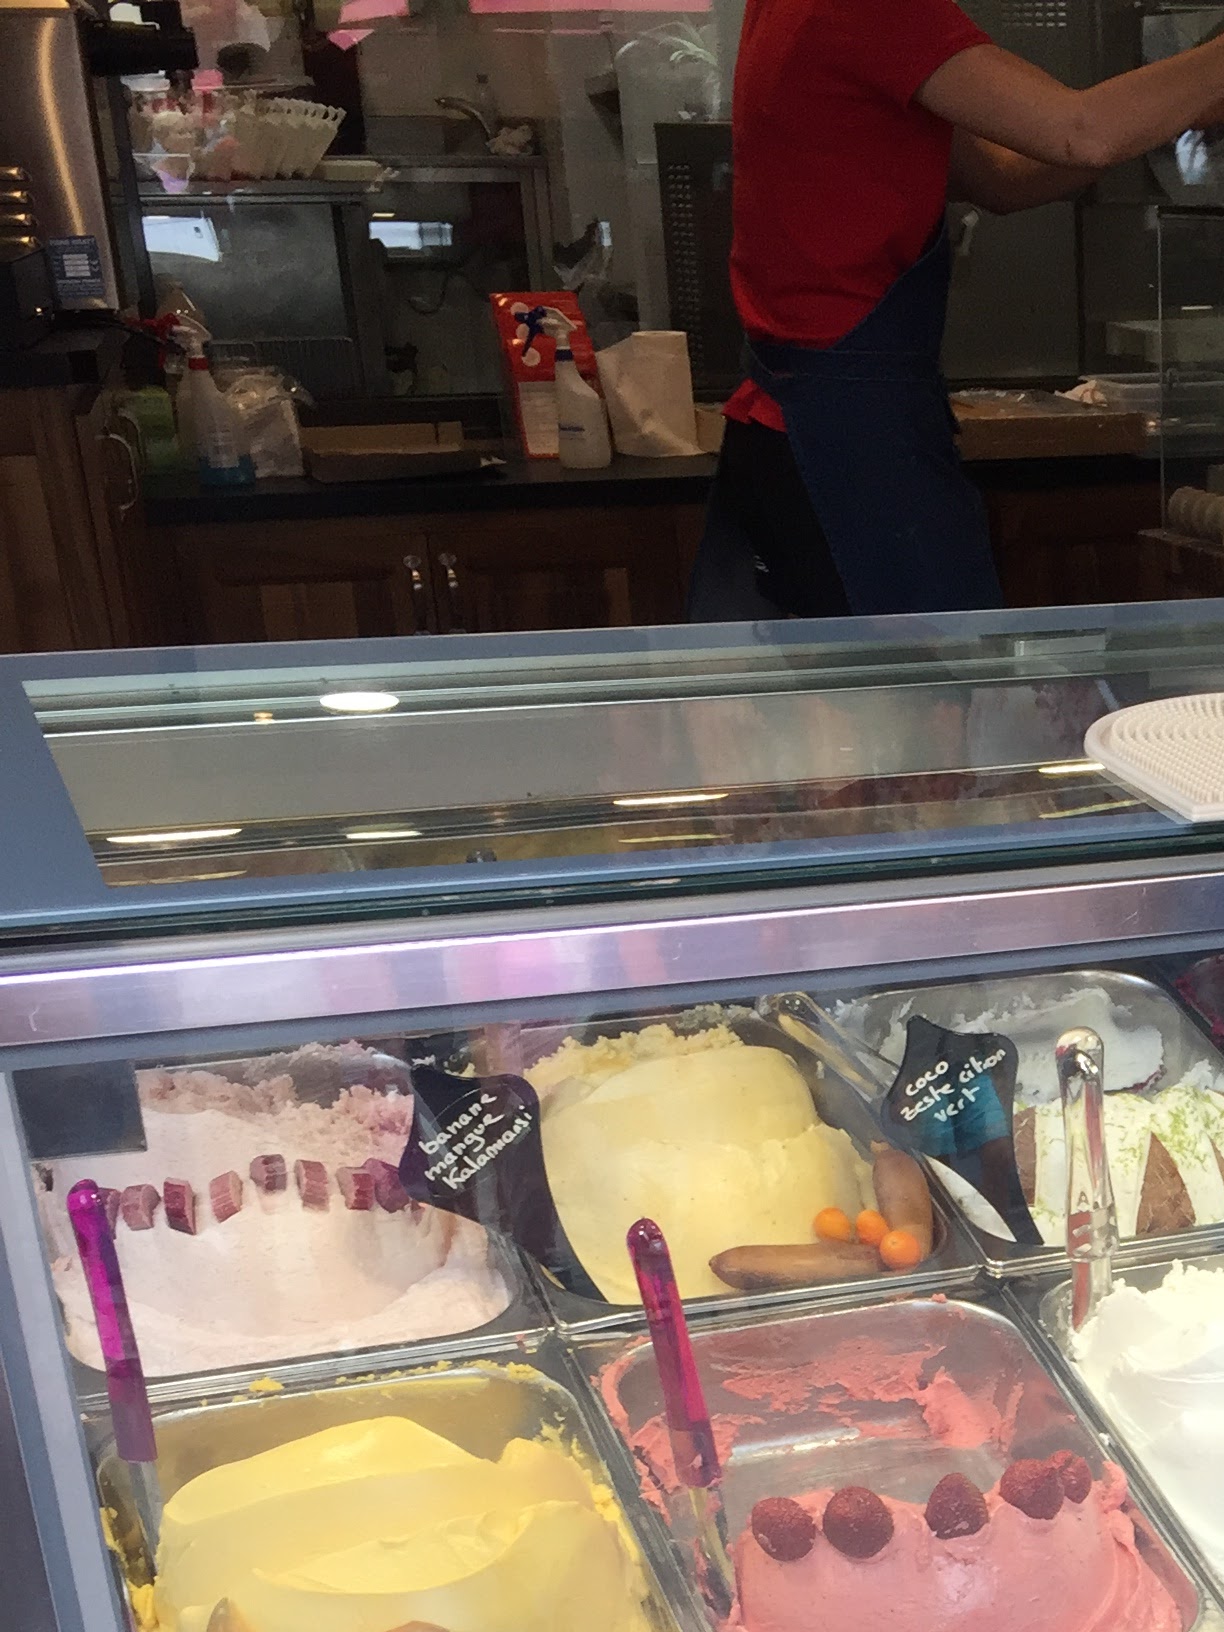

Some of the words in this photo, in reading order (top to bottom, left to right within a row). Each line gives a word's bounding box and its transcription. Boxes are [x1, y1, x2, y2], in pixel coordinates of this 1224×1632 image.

[905, 1060, 949, 1097] coco
[418, 1093, 498, 1155] banane
[933, 1085, 981, 1122] vert
[424, 1113, 505, 1181] mangue
